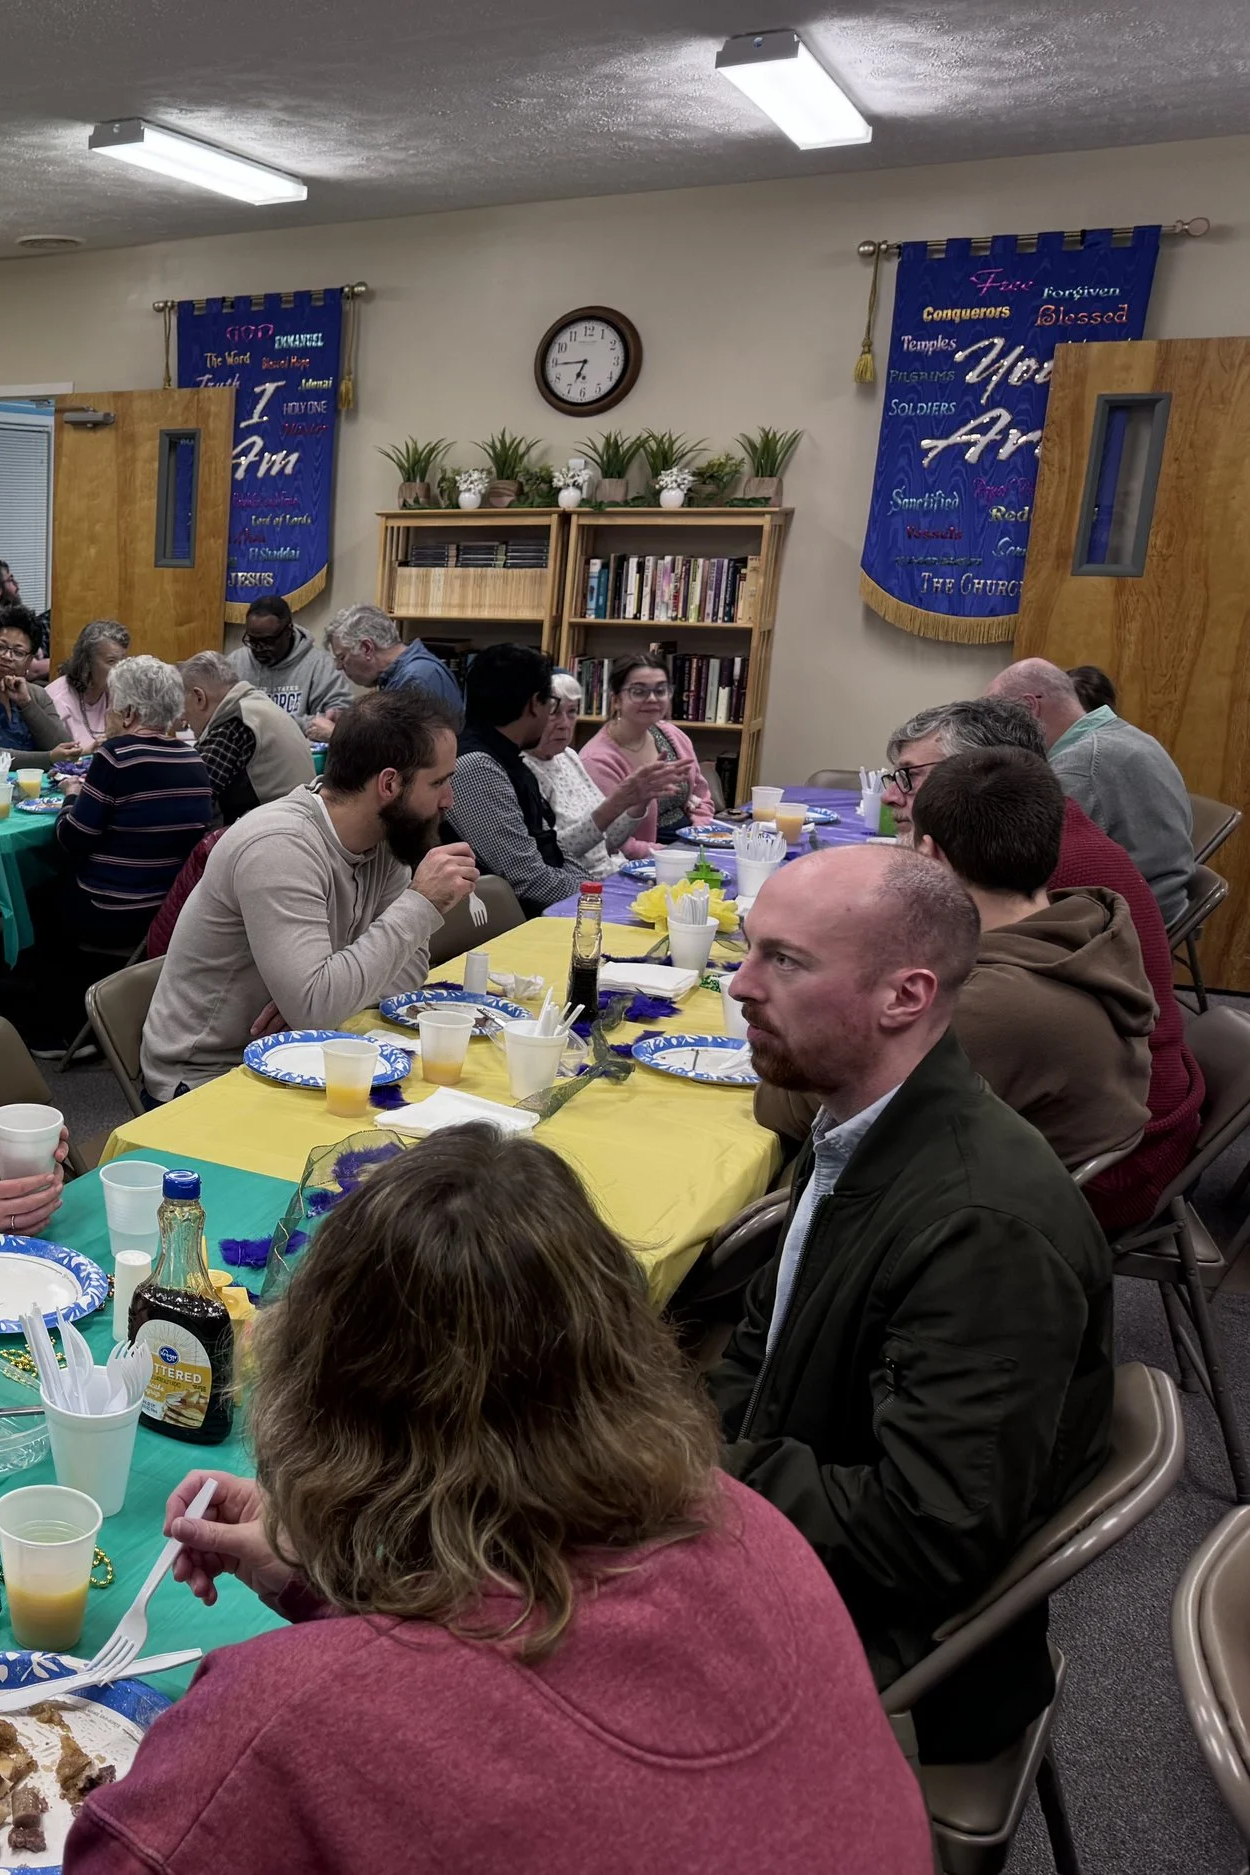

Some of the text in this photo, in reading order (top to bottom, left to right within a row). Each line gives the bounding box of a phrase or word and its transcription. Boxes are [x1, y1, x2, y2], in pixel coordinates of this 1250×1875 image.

[969, 268, 1034, 298] Free
[1042, 286, 1121, 301] Forgiven
[922, 305, 1011, 324] Conquerors
[1034, 303, 1129, 327] Blessed
[274, 332, 324, 349] EMMANUEL
[569, 331, 577, 342] 11
[584, 325, 595, 337] 12
[557, 342, 567, 354] 10
[901, 335, 957, 356] Temples
[204, 350, 250, 368] The Word
[239, 380, 287, 429] I
[920, 408, 1042, 468] Ar
[231, 435, 299, 481] Am
[886, 484, 960, 517] Sanctified
[988, 505, 1031, 522] Red
[228, 571, 274, 588] JESUS
[266, 691, 303, 714] ORCE
[154, 1363, 202, 1384] TTERED
